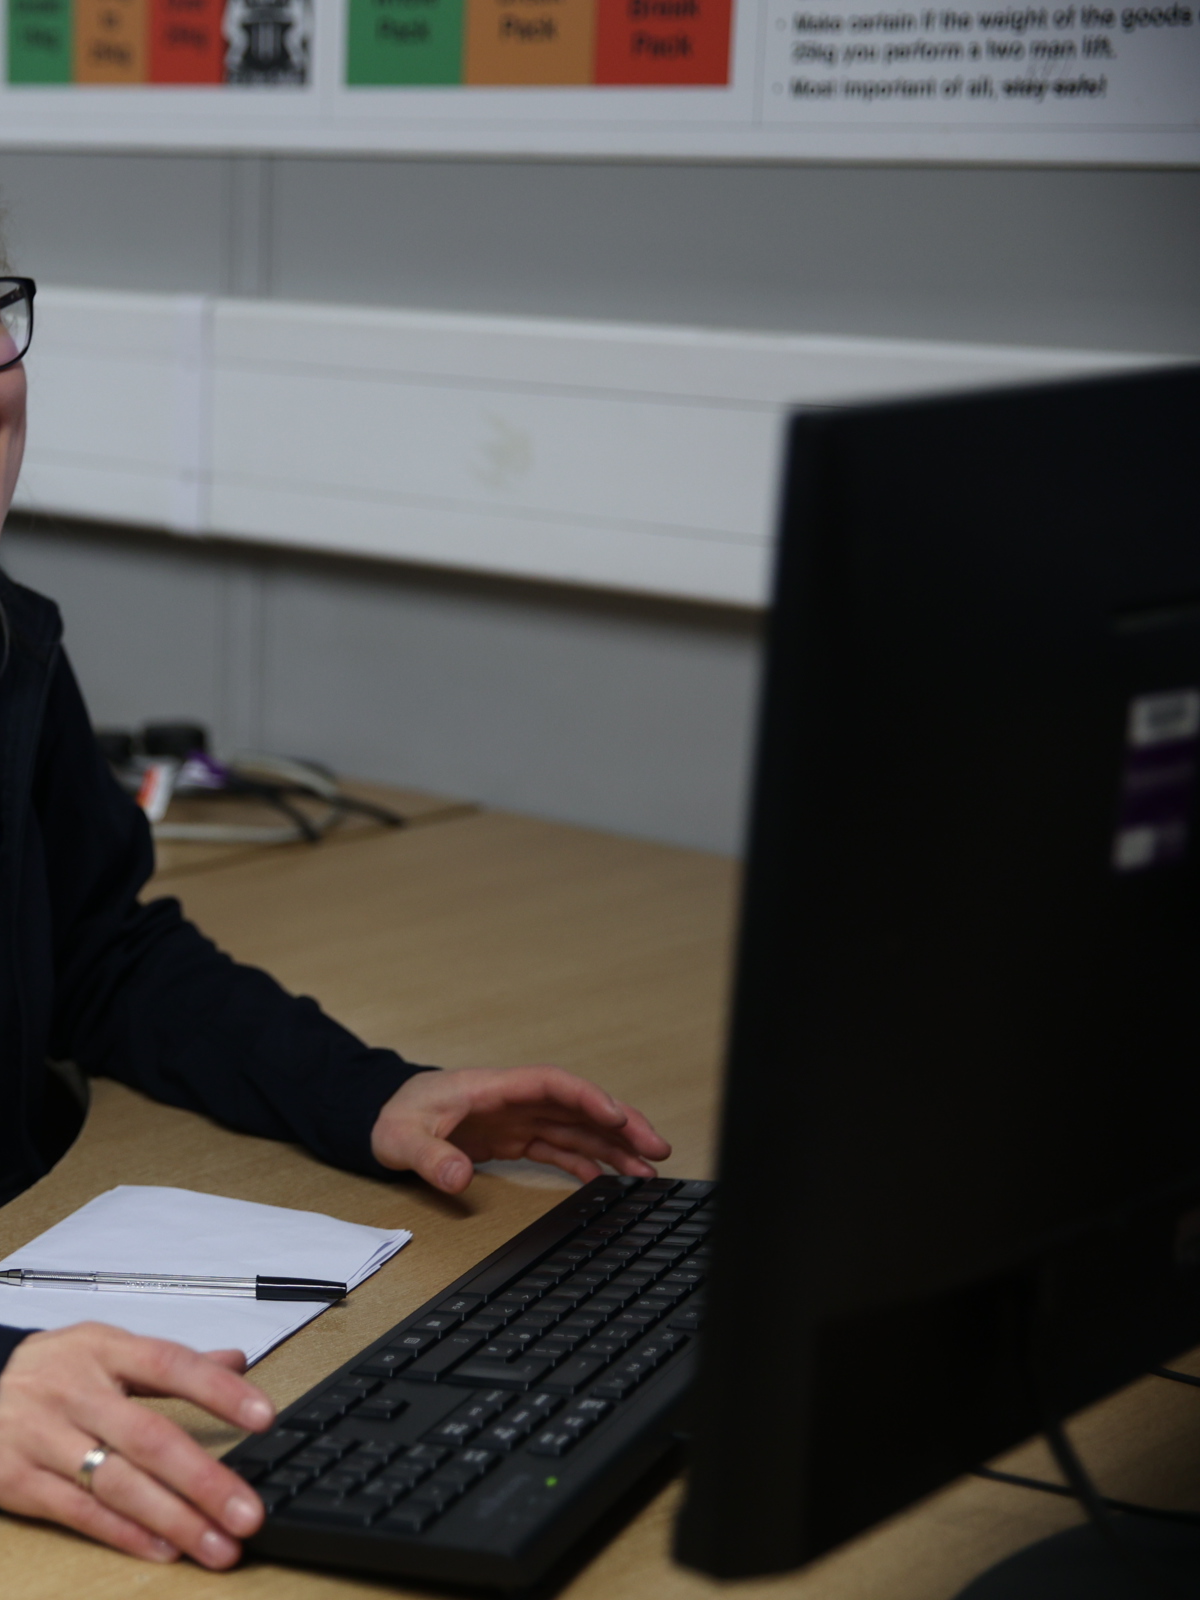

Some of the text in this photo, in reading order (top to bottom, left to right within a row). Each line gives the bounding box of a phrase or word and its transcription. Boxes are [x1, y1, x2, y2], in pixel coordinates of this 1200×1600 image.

[794, 3, 1192, 36] Make certain if the weight of the goods
[842, 43, 880, 69] you
[883, 38, 964, 68] perform
[967, 41, 983, 61] a
[986, 38, 1025, 61] two
[1030, 41, 1077, 60] man
[790, 76, 837, 99] Most
[841, 76, 936, 103] important
[941, 75, 963, 99] of
[1002, 76, 1047, 104] stay
